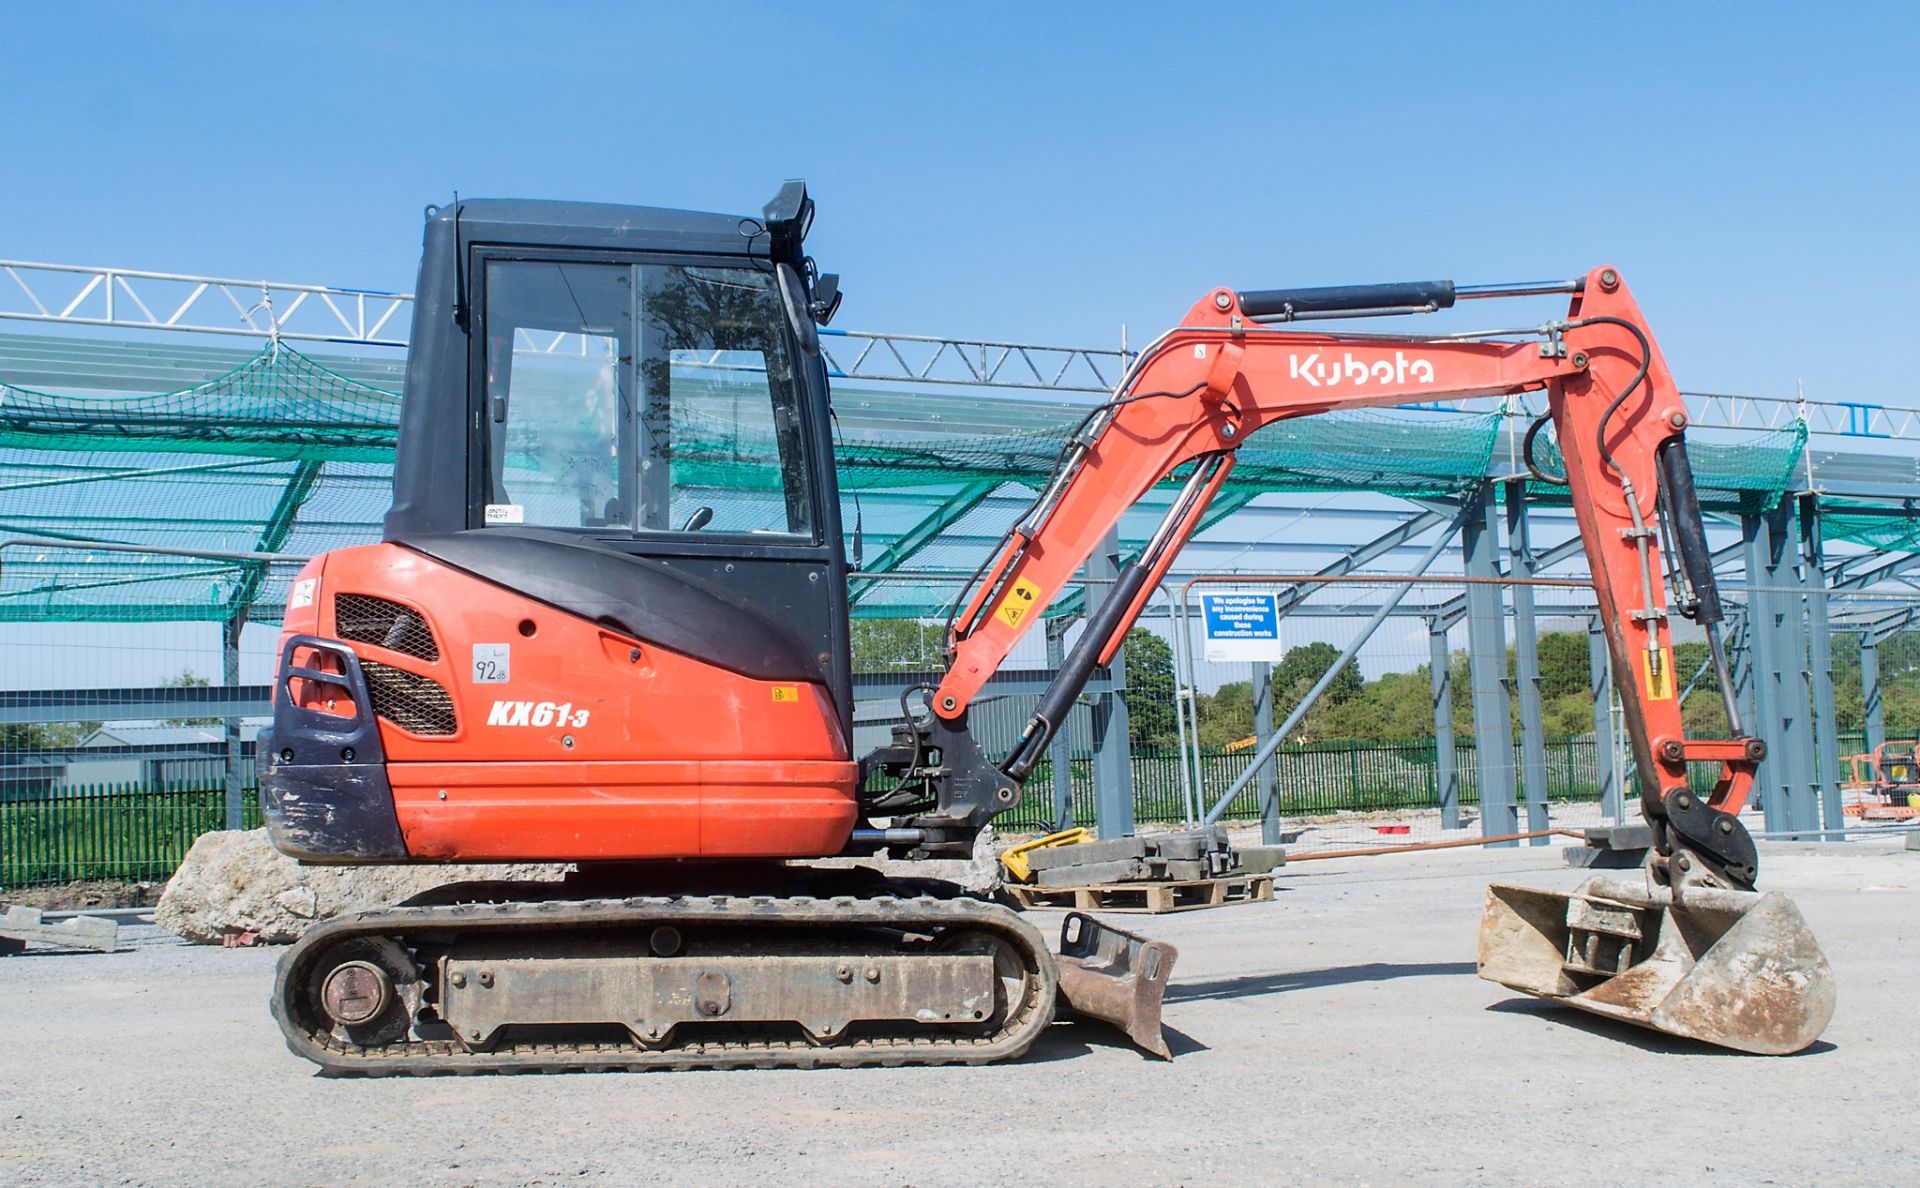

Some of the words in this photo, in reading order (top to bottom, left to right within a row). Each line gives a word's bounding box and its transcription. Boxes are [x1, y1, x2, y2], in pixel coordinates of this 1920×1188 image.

[1289, 351, 1434, 387] Kubota
[1225, 597, 1256, 606] apologise
[1225, 605, 1270, 613] inconvenience
[1243, 614, 1264, 622] during
[476, 661, 496, 680] 92
[486, 700, 590, 728] KX61-3
